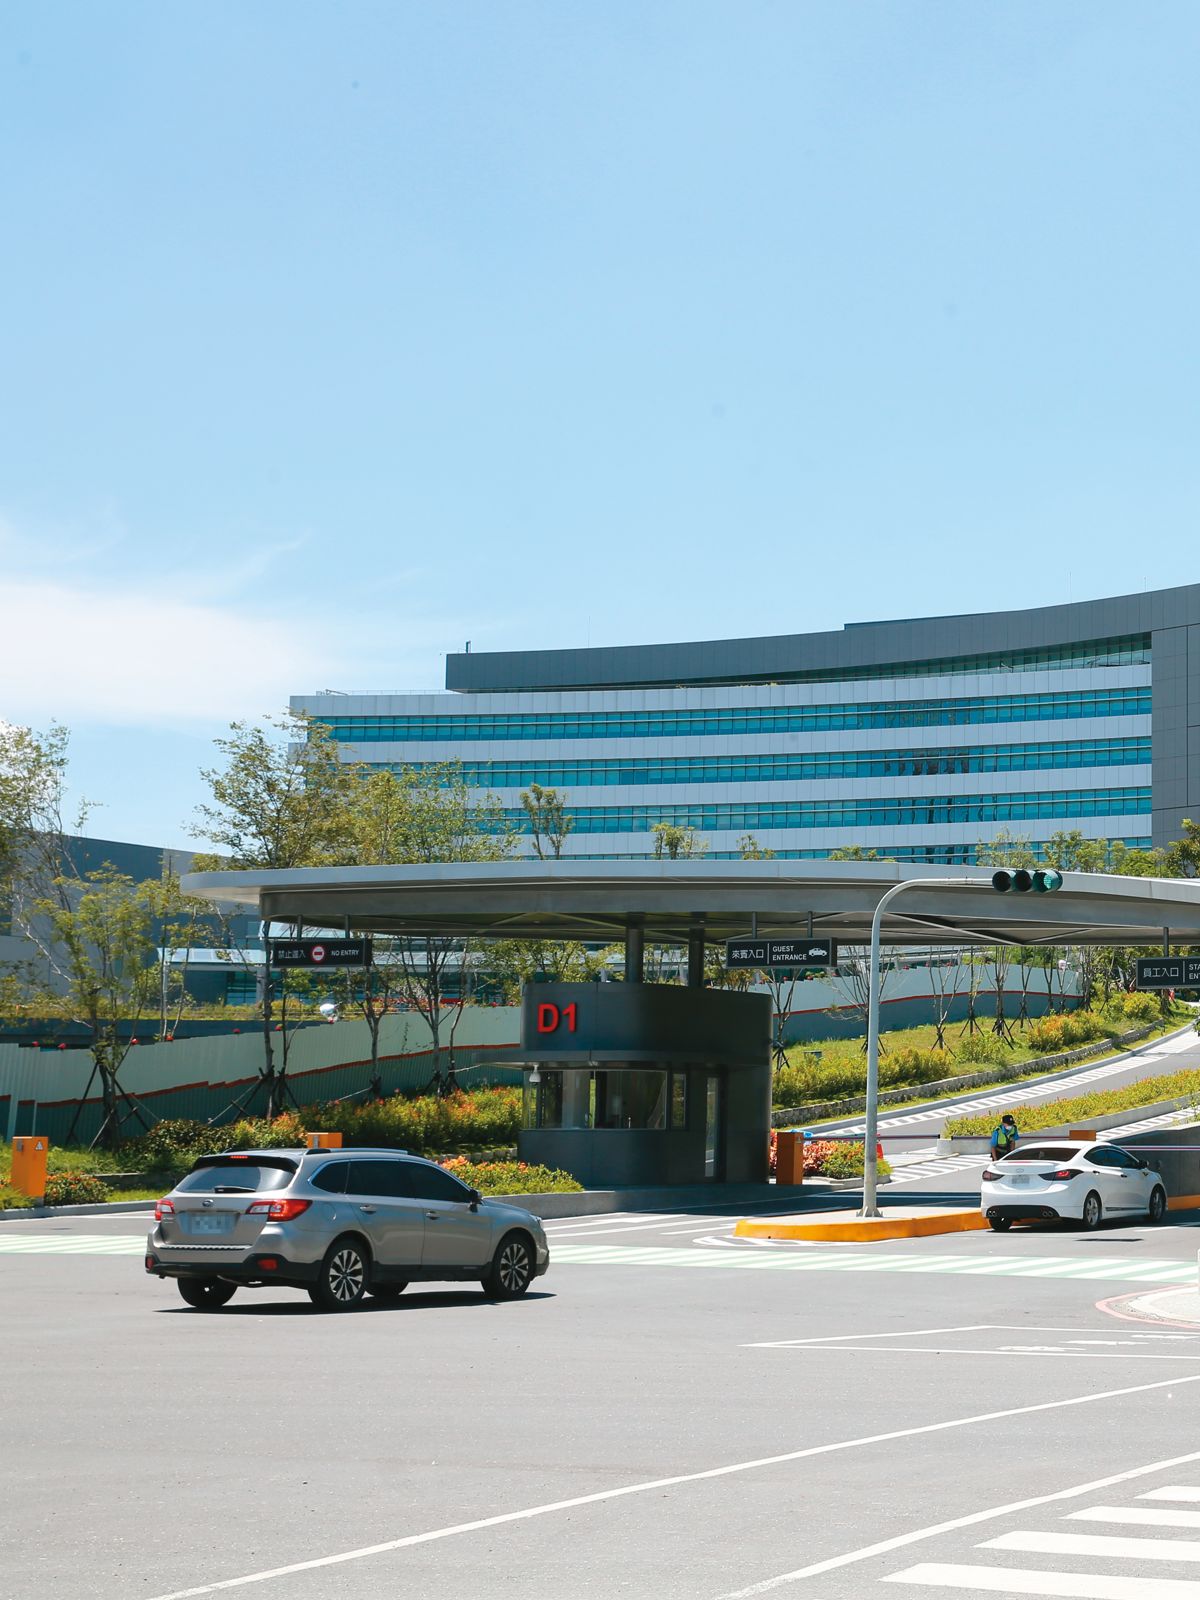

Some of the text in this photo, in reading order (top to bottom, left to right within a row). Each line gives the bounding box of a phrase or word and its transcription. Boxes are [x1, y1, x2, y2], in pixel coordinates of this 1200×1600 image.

[732, 949, 764, 959] 來賓入口
[1143, 967, 1179, 978] 員工入口
[537, 1002, 577, 1033] D1
